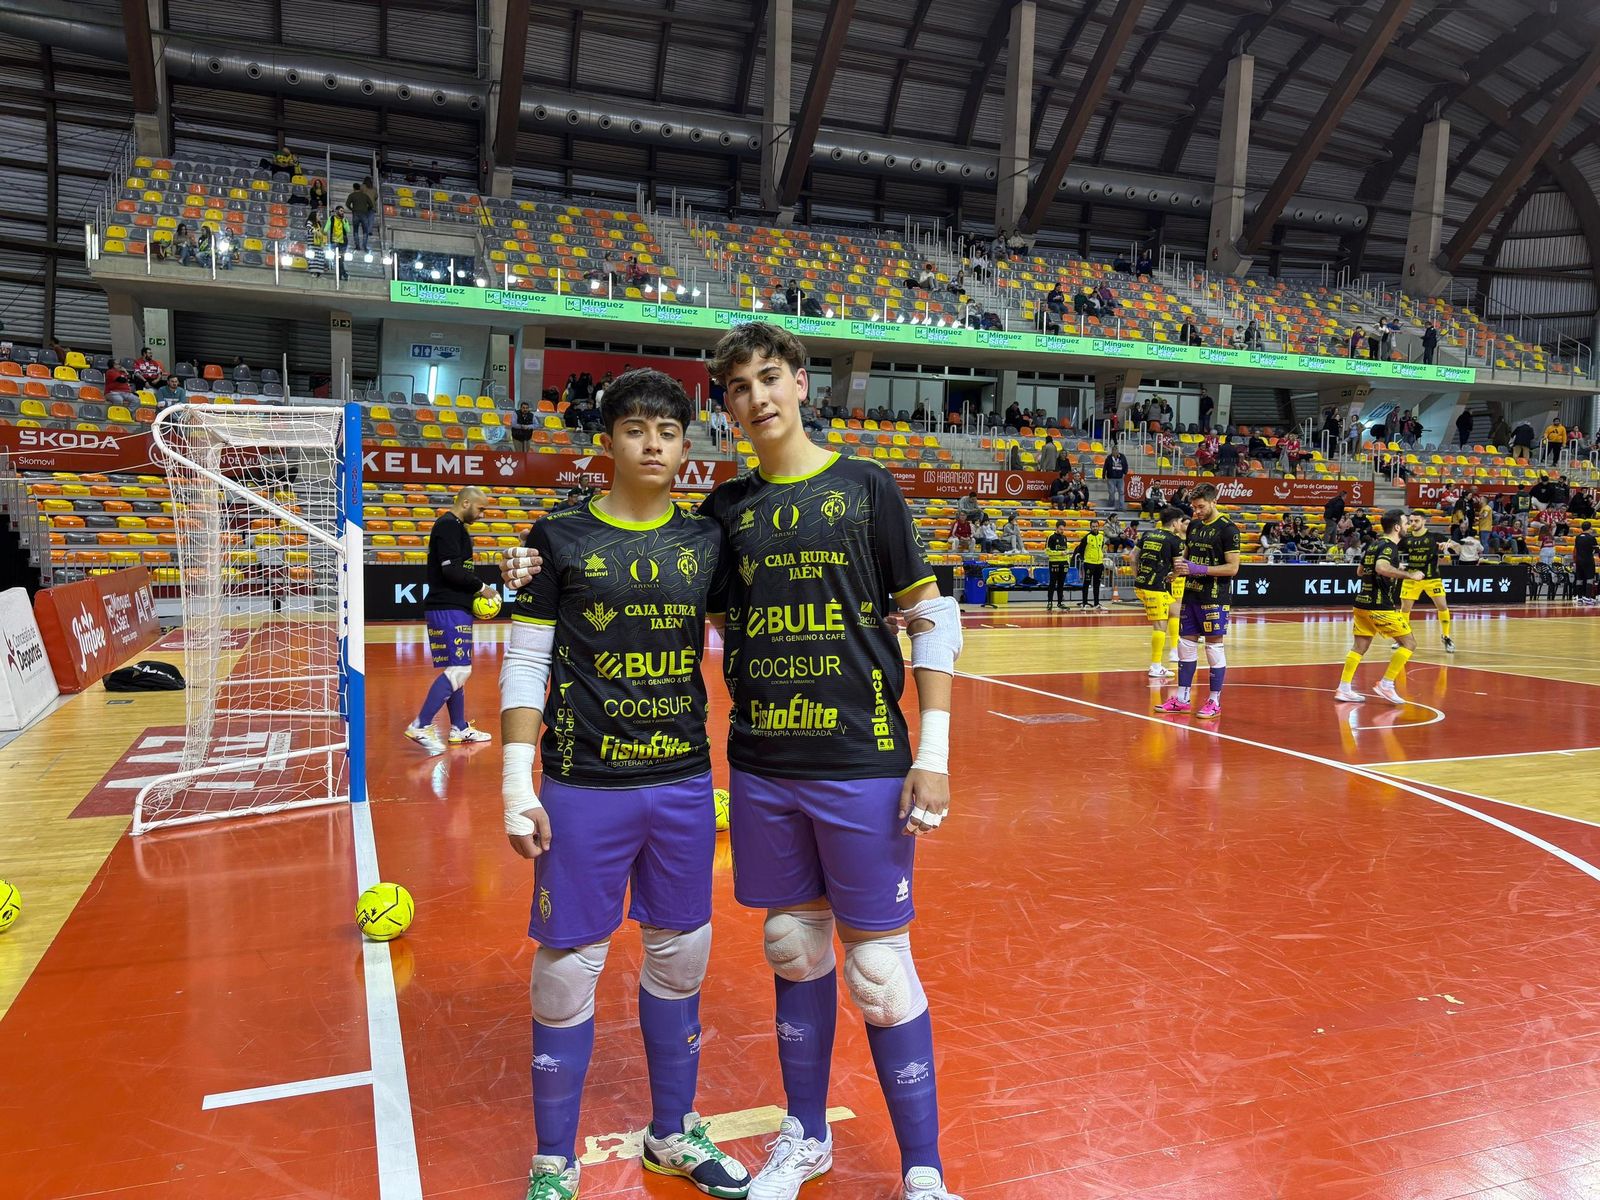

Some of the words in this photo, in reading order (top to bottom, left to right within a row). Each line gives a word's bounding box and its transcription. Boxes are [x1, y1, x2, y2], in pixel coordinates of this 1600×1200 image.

[18, 457, 55, 467] Skomovil
[362, 451, 484, 476] KELME
[556, 472, 609, 484] NIMTEL
[923, 470, 935, 483] LOS
[936, 471, 975, 485] HABANEROS
[1026, 483, 1049, 491] REGIÓN
[1216, 479, 1253, 500] Jimbee
[764, 552, 797, 567] CAJA
[800, 550, 849, 566] RURAL
[788, 565, 823, 582] JAÉN
[1305, 579, 1361, 595] KELM
[1442, 578, 1493, 593] ELME
[624, 604, 659, 617] CAJA
[650, 616, 684, 630] JAÉN
[771, 635, 784, 643] BAR
[785, 634, 817, 642] GENUINO
[819, 633, 824, 641] &
[825, 632, 846, 641] CAFÉ
[16, 643, 42, 672] Deportes
[750, 655, 843, 679] COCISUR
[632, 679, 646, 687] BAR
[604, 696, 692, 719] COCISUR
[871, 668, 890, 737] Blanca
[556, 708, 565, 725] DE
[750, 693, 838, 730] FisioÉlite
[792, 729, 833, 737] AVANZADA
[561, 708, 575, 777] DIPUTACIÓN
[600, 731, 691, 761] FisioÉlite
[896, 1072, 929, 1085] luanvi
